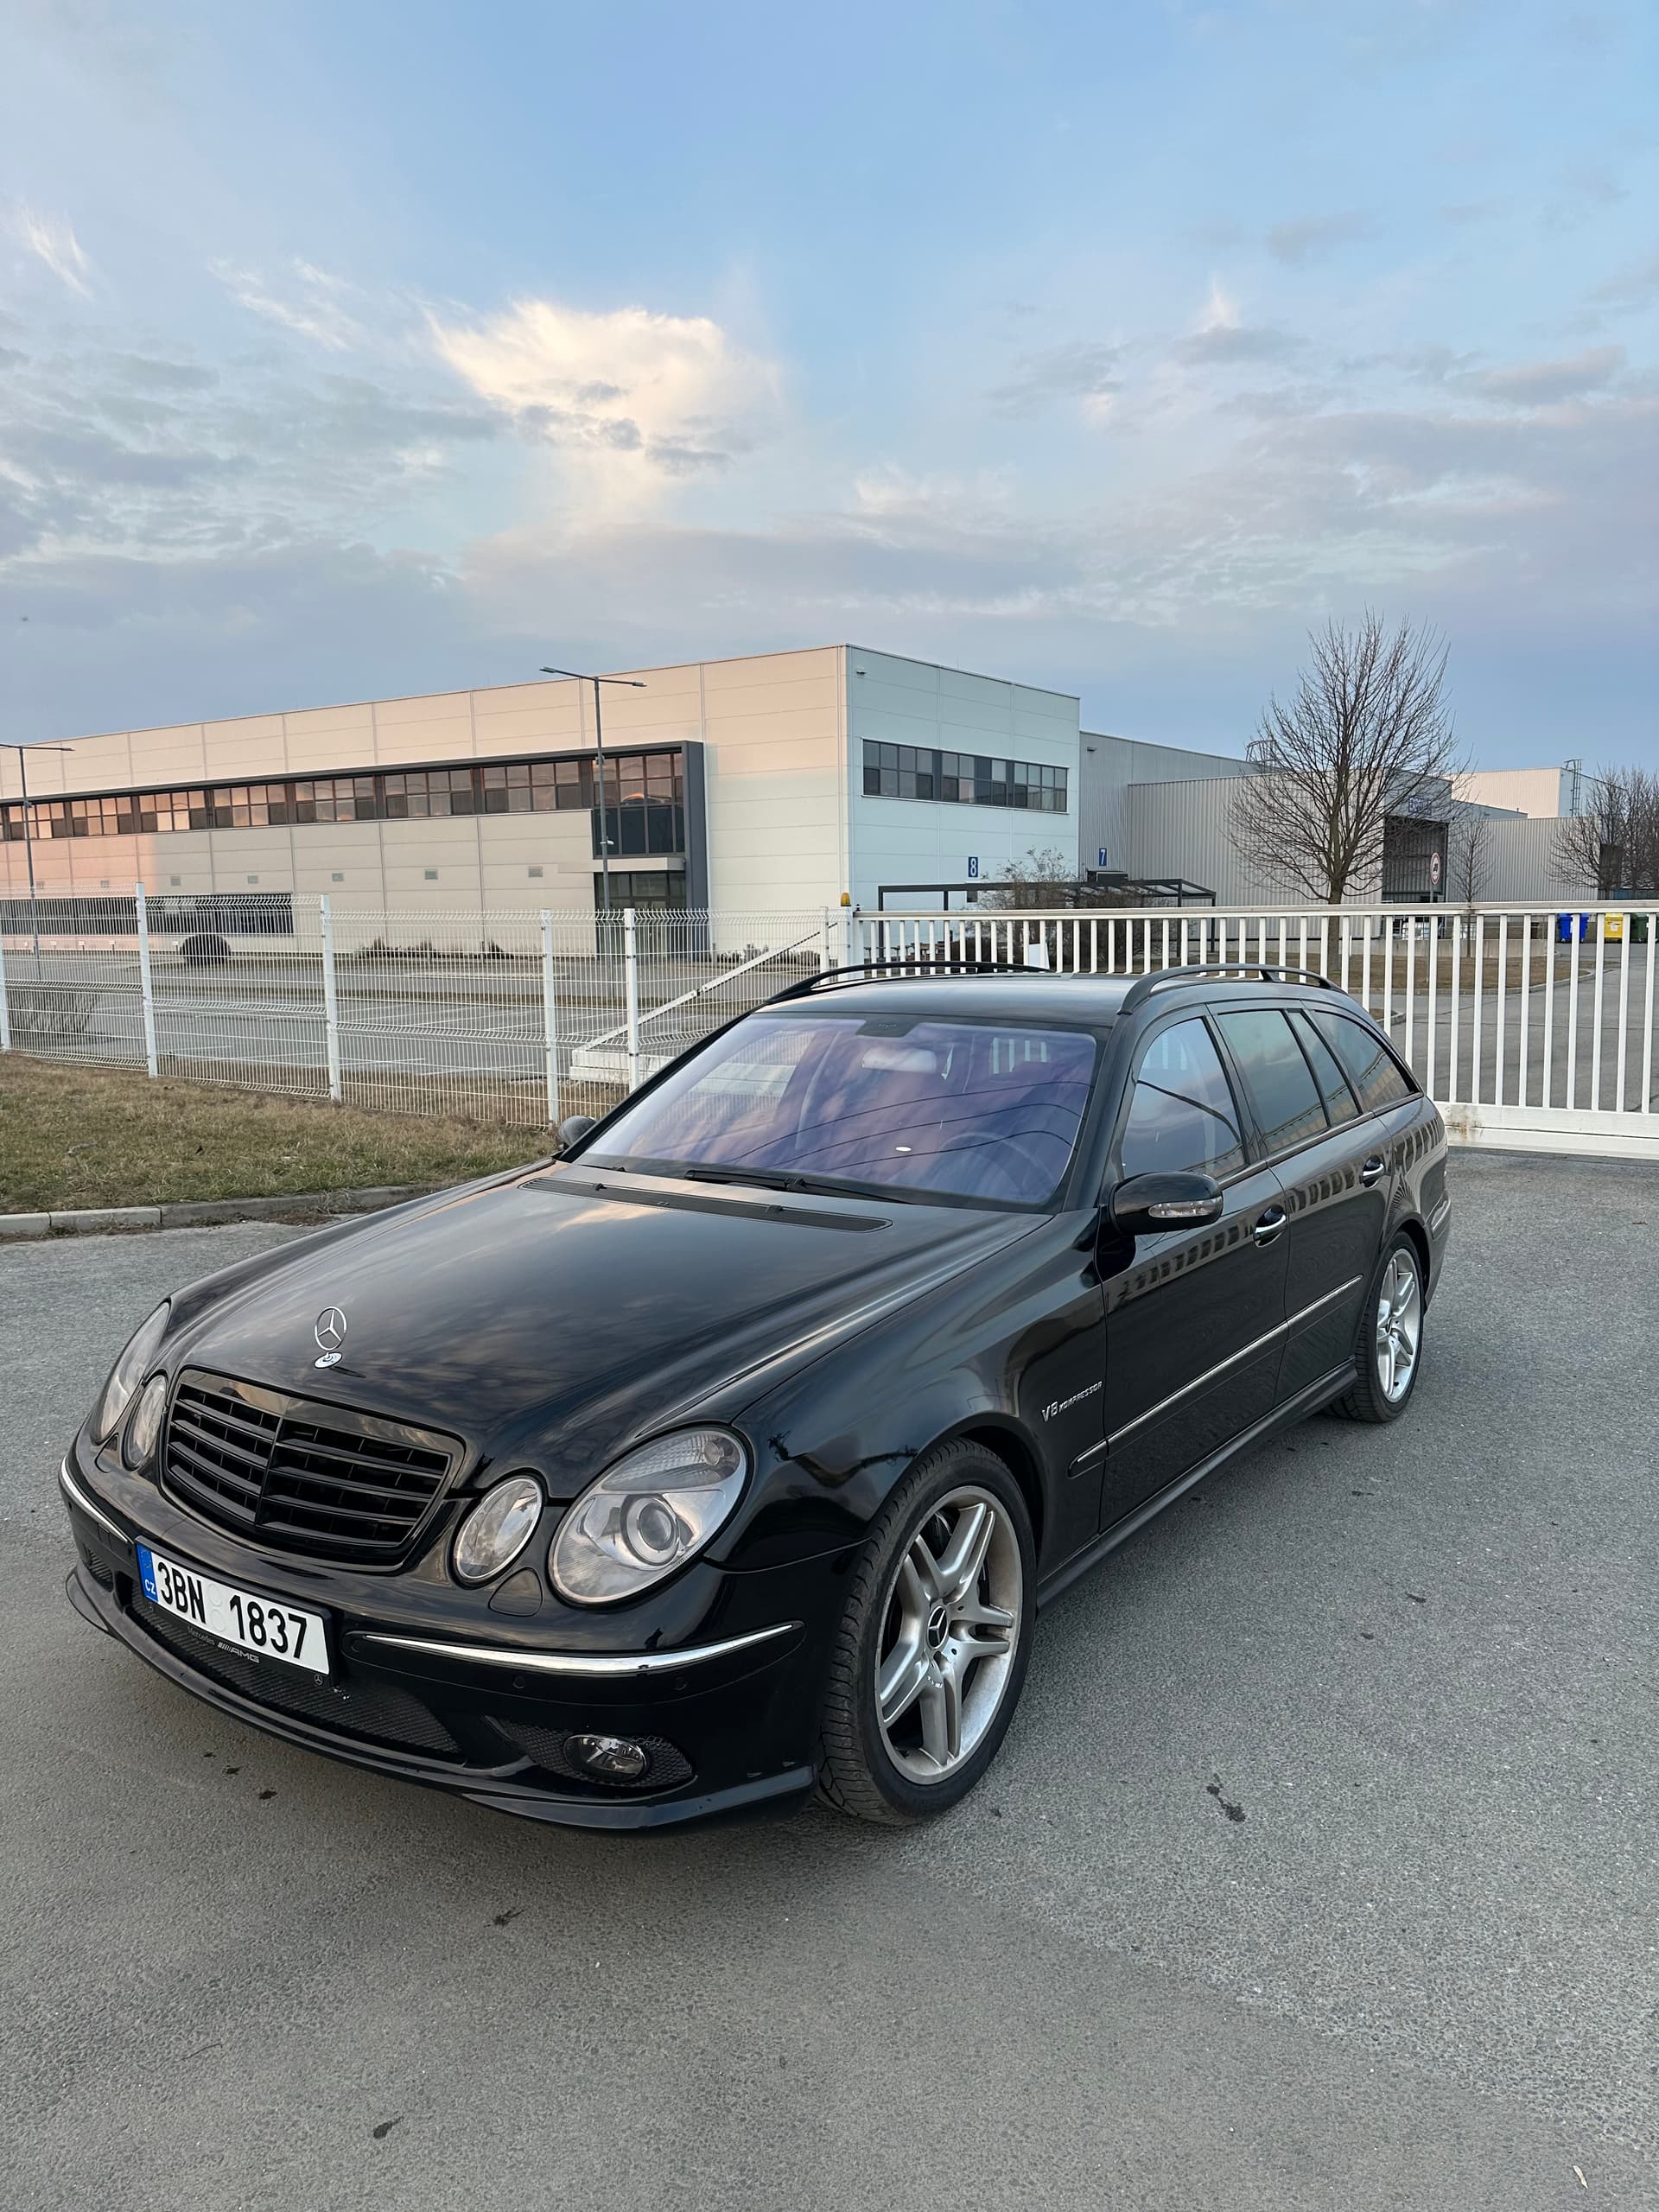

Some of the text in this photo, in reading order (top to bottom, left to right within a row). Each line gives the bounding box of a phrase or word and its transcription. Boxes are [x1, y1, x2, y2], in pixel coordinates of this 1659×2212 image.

[969, 858, 977, 876] 8
[1041, 1401, 1058, 1422] V8
[144, 1579, 156, 1595] CZ
[157, 1561, 308, 1660] 3BN 1837
[230, 1647, 260, 1663] AMG
